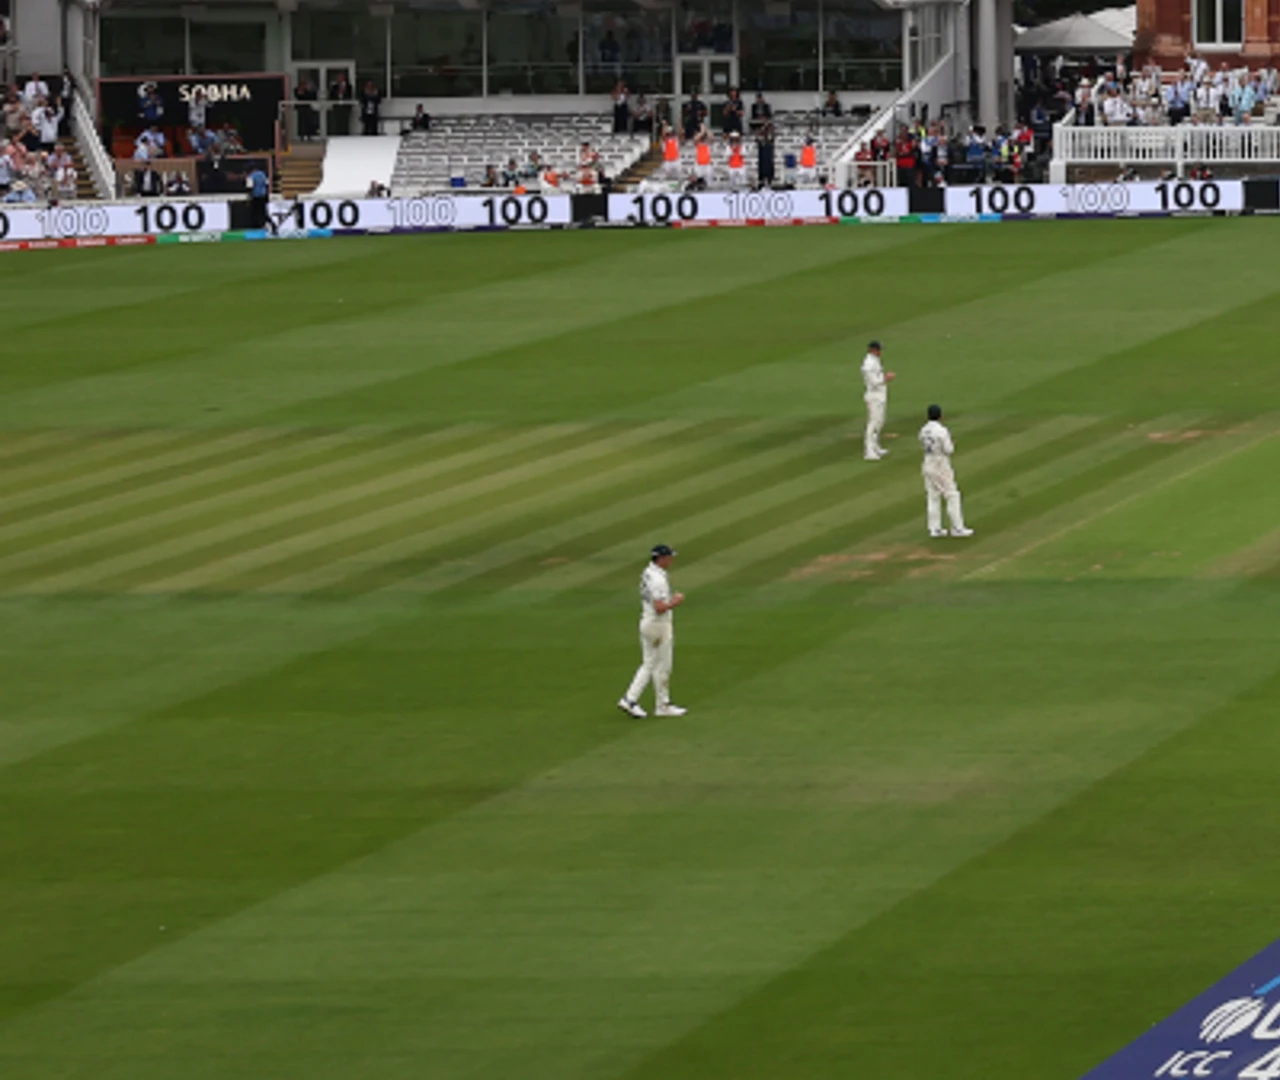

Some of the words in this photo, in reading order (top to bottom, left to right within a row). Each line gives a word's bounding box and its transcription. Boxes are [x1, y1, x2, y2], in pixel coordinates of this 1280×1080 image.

[289, 199, 361, 228] 100
[481, 196, 549, 224] 100
[631, 195, 699, 221] 100
[817, 190, 886, 217] 100
[968, 186, 1036, 213] 100
[1154, 183, 1221, 209] 100
[134, 204, 207, 233] 100
[1154, 1051, 1233, 1078] ICC
